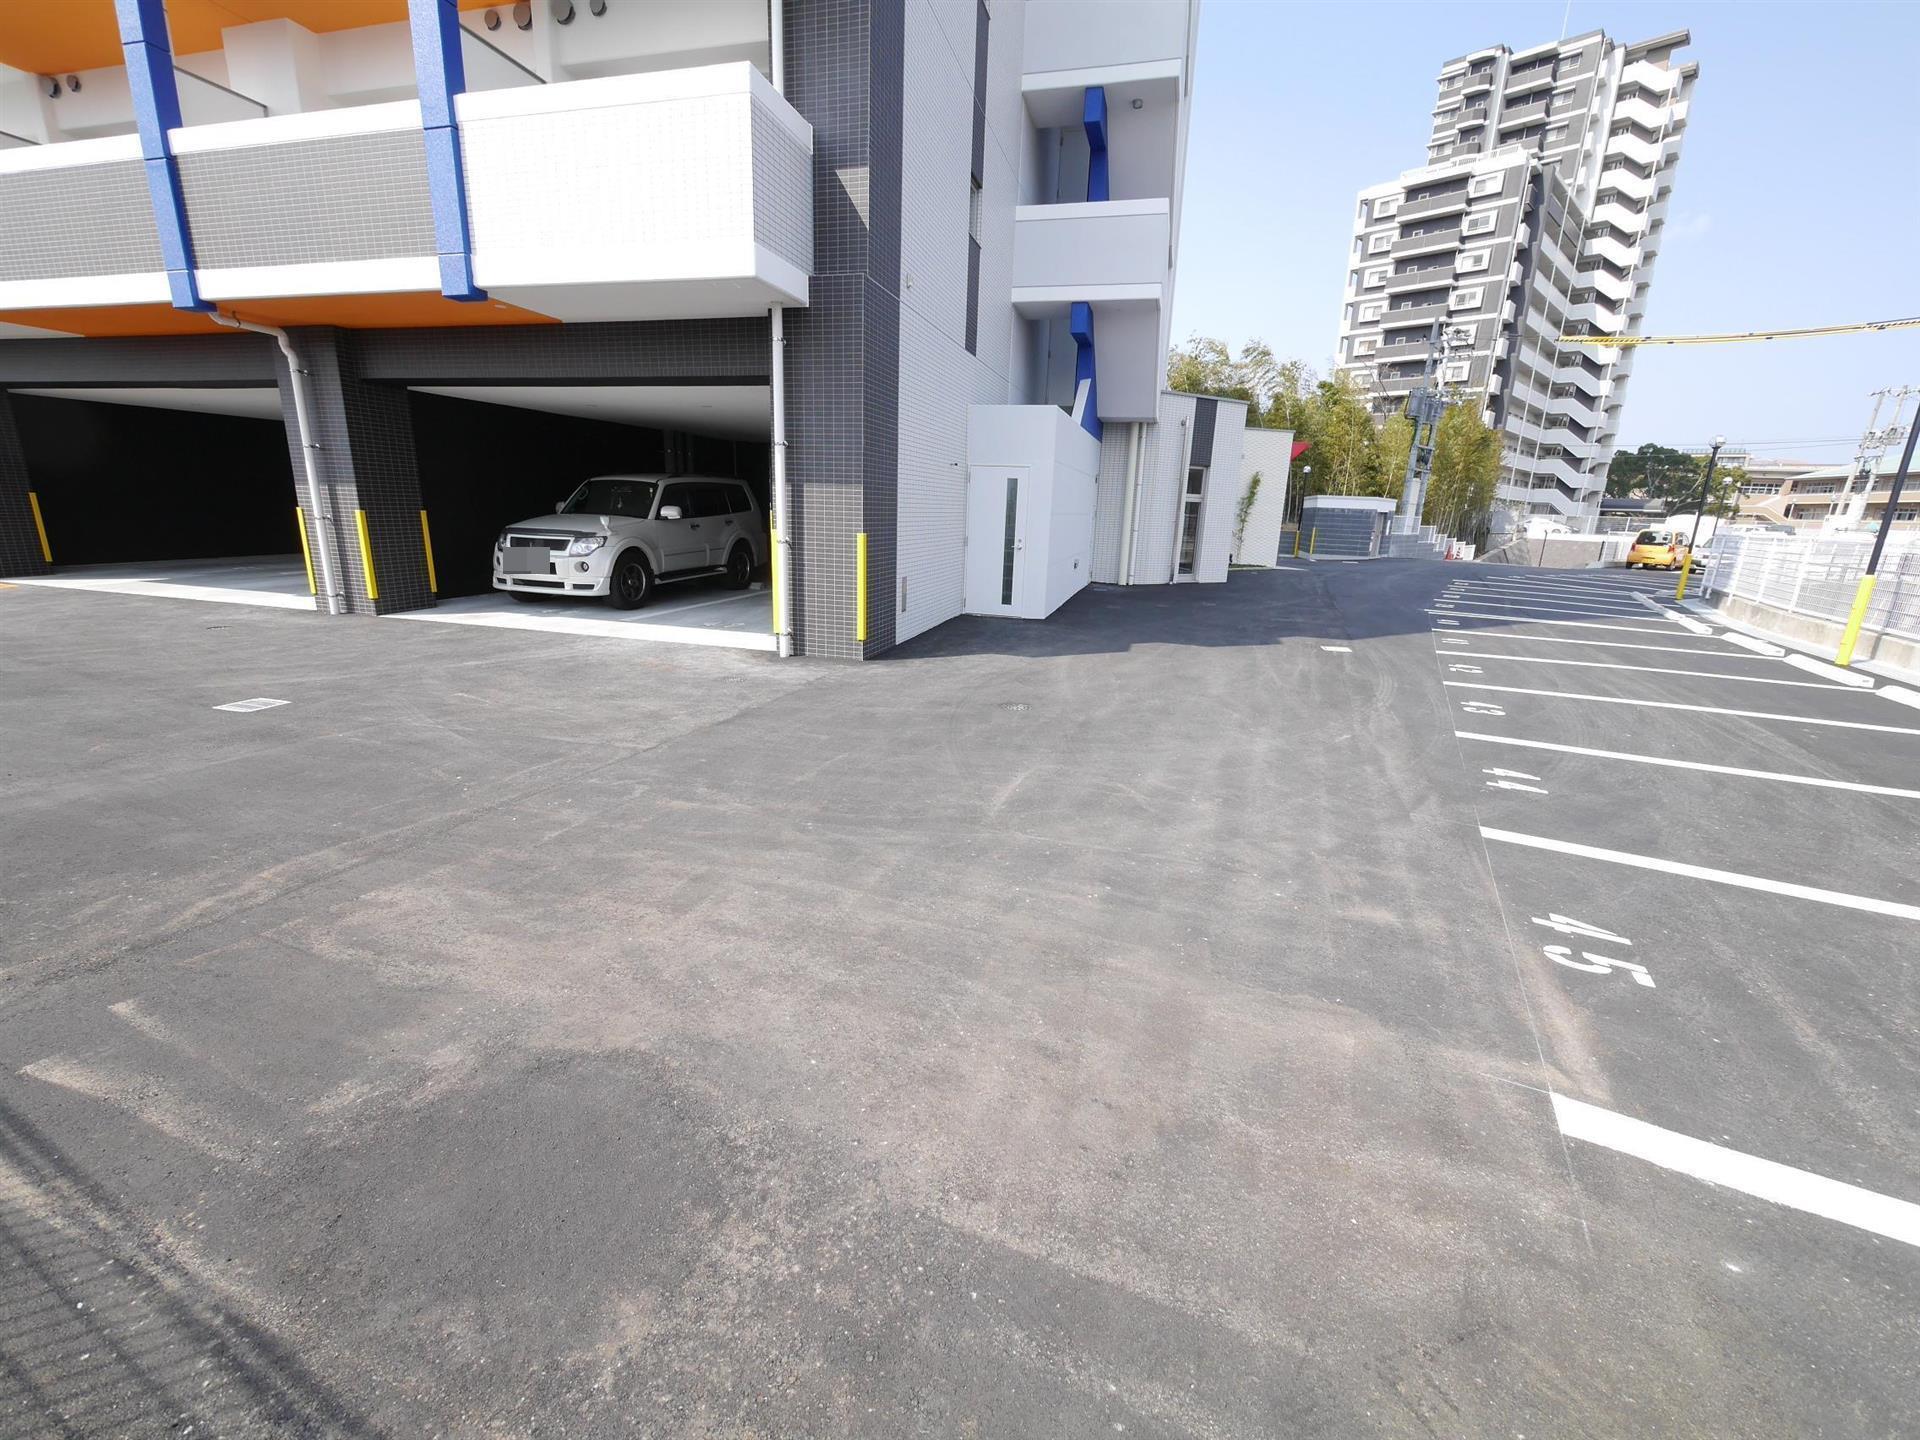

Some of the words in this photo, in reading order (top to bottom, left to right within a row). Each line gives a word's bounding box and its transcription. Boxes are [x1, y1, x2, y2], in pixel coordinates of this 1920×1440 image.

[1460, 701, 1506, 716] 43
[1482, 767, 1549, 795] 44
[1531, 912, 1656, 988] 45
